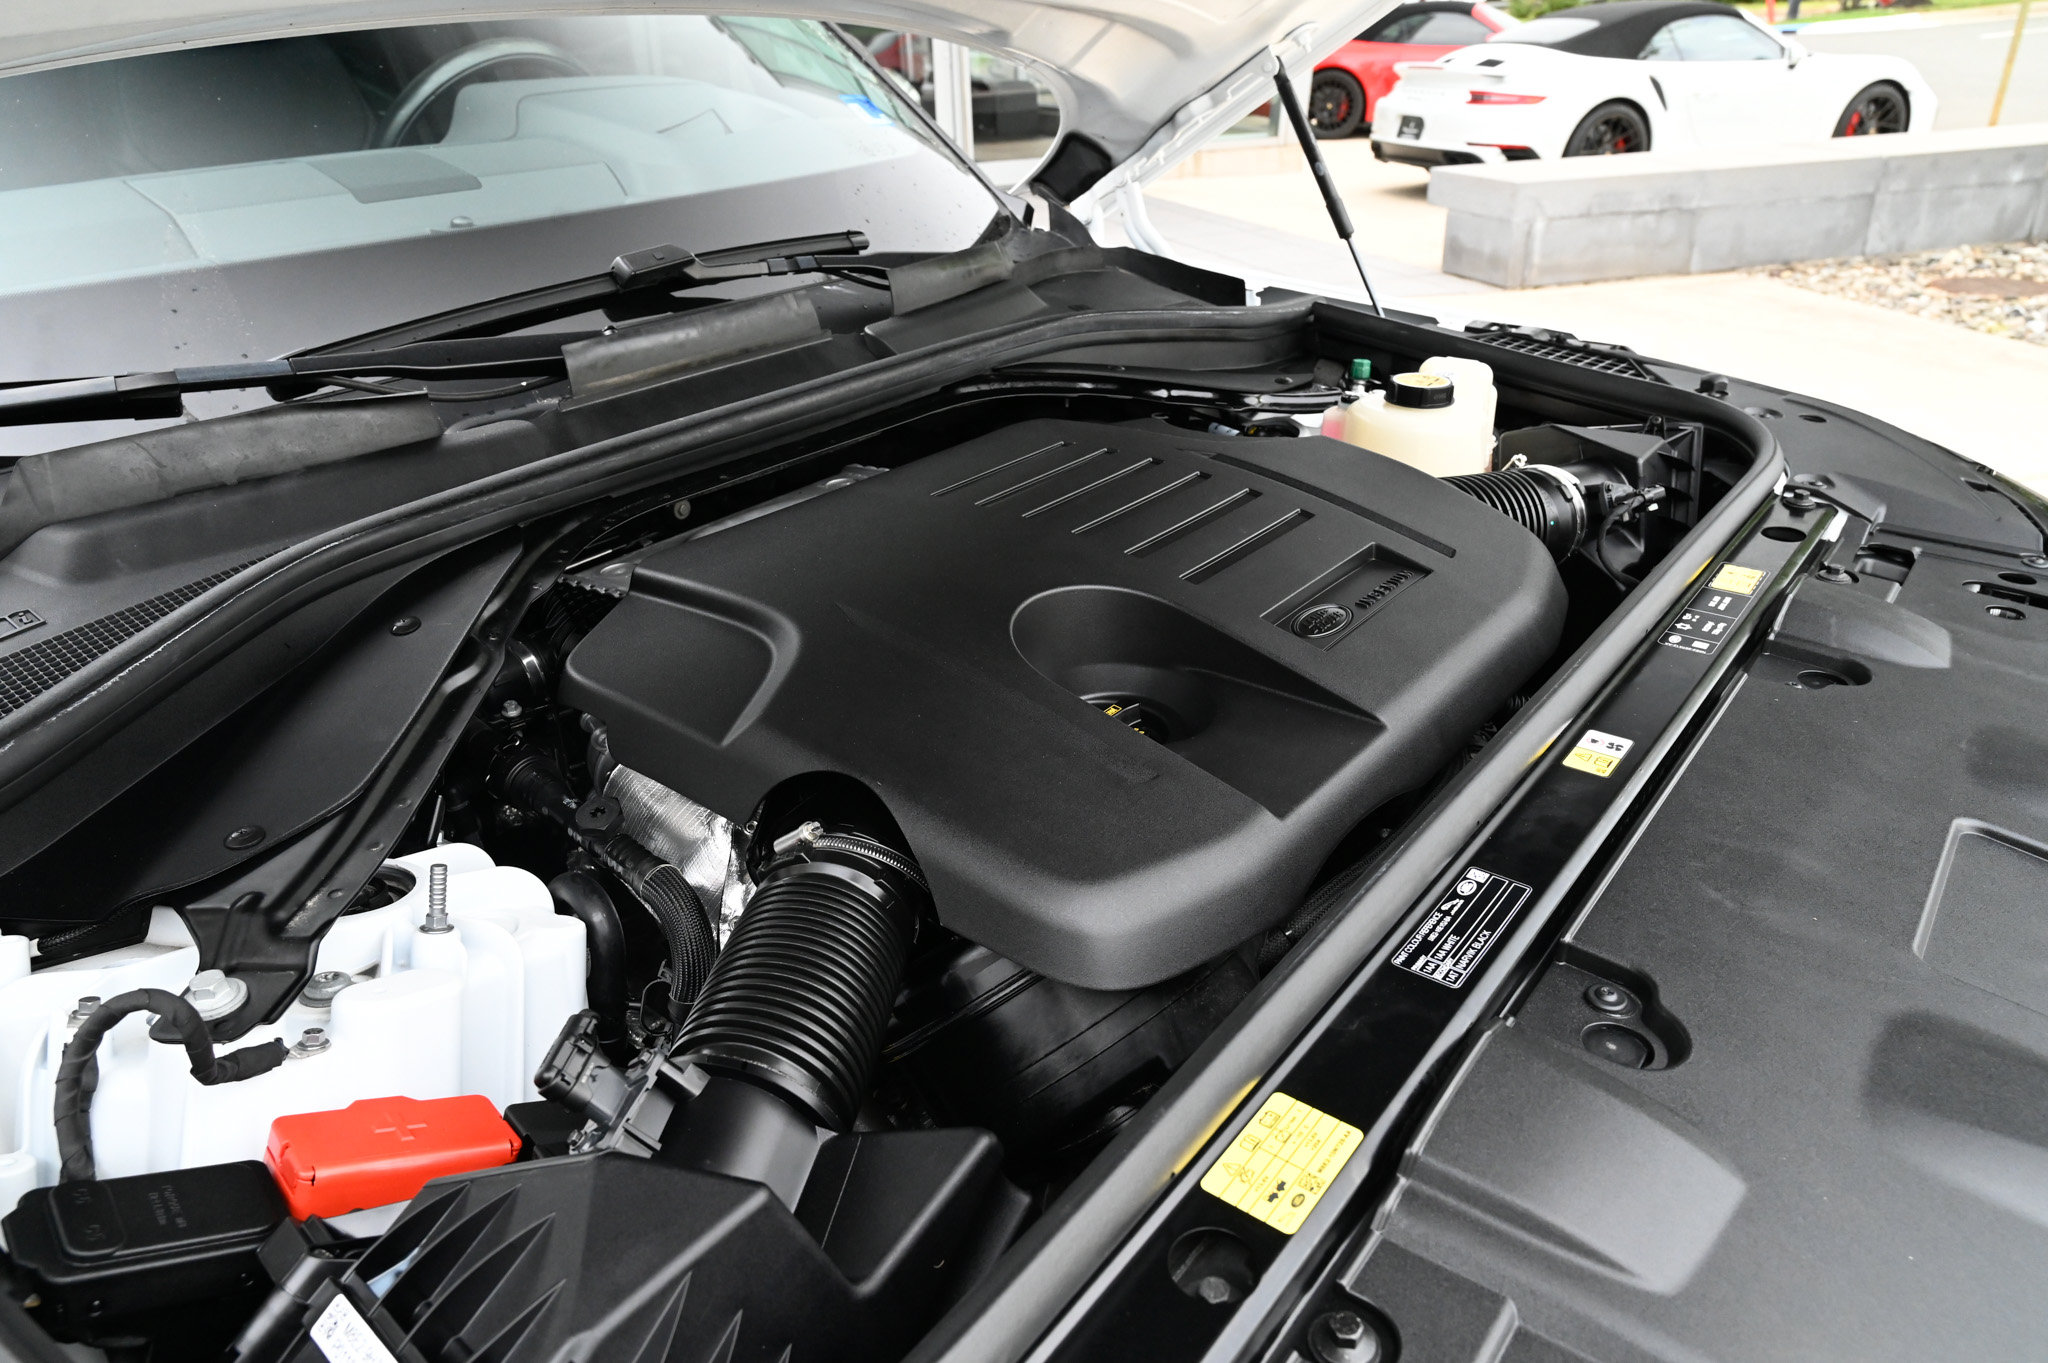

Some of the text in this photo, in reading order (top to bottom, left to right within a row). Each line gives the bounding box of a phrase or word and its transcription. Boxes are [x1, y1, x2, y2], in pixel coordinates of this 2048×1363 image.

[1354, 569, 1415, 609] INGENIUM
[1393, 950, 1410, 964] PAINT
[1404, 933, 1425, 953] COLOUR
[1418, 911, 1444, 937] REFERENCE
[1433, 949, 1448, 961] 1AA
[1441, 934, 1461, 951] WHITE
[1456, 930, 1492, 970] NARVIK BLACK
[1422, 961, 1438, 974] 1AA
[1445, 970, 1460, 983] 1AT
